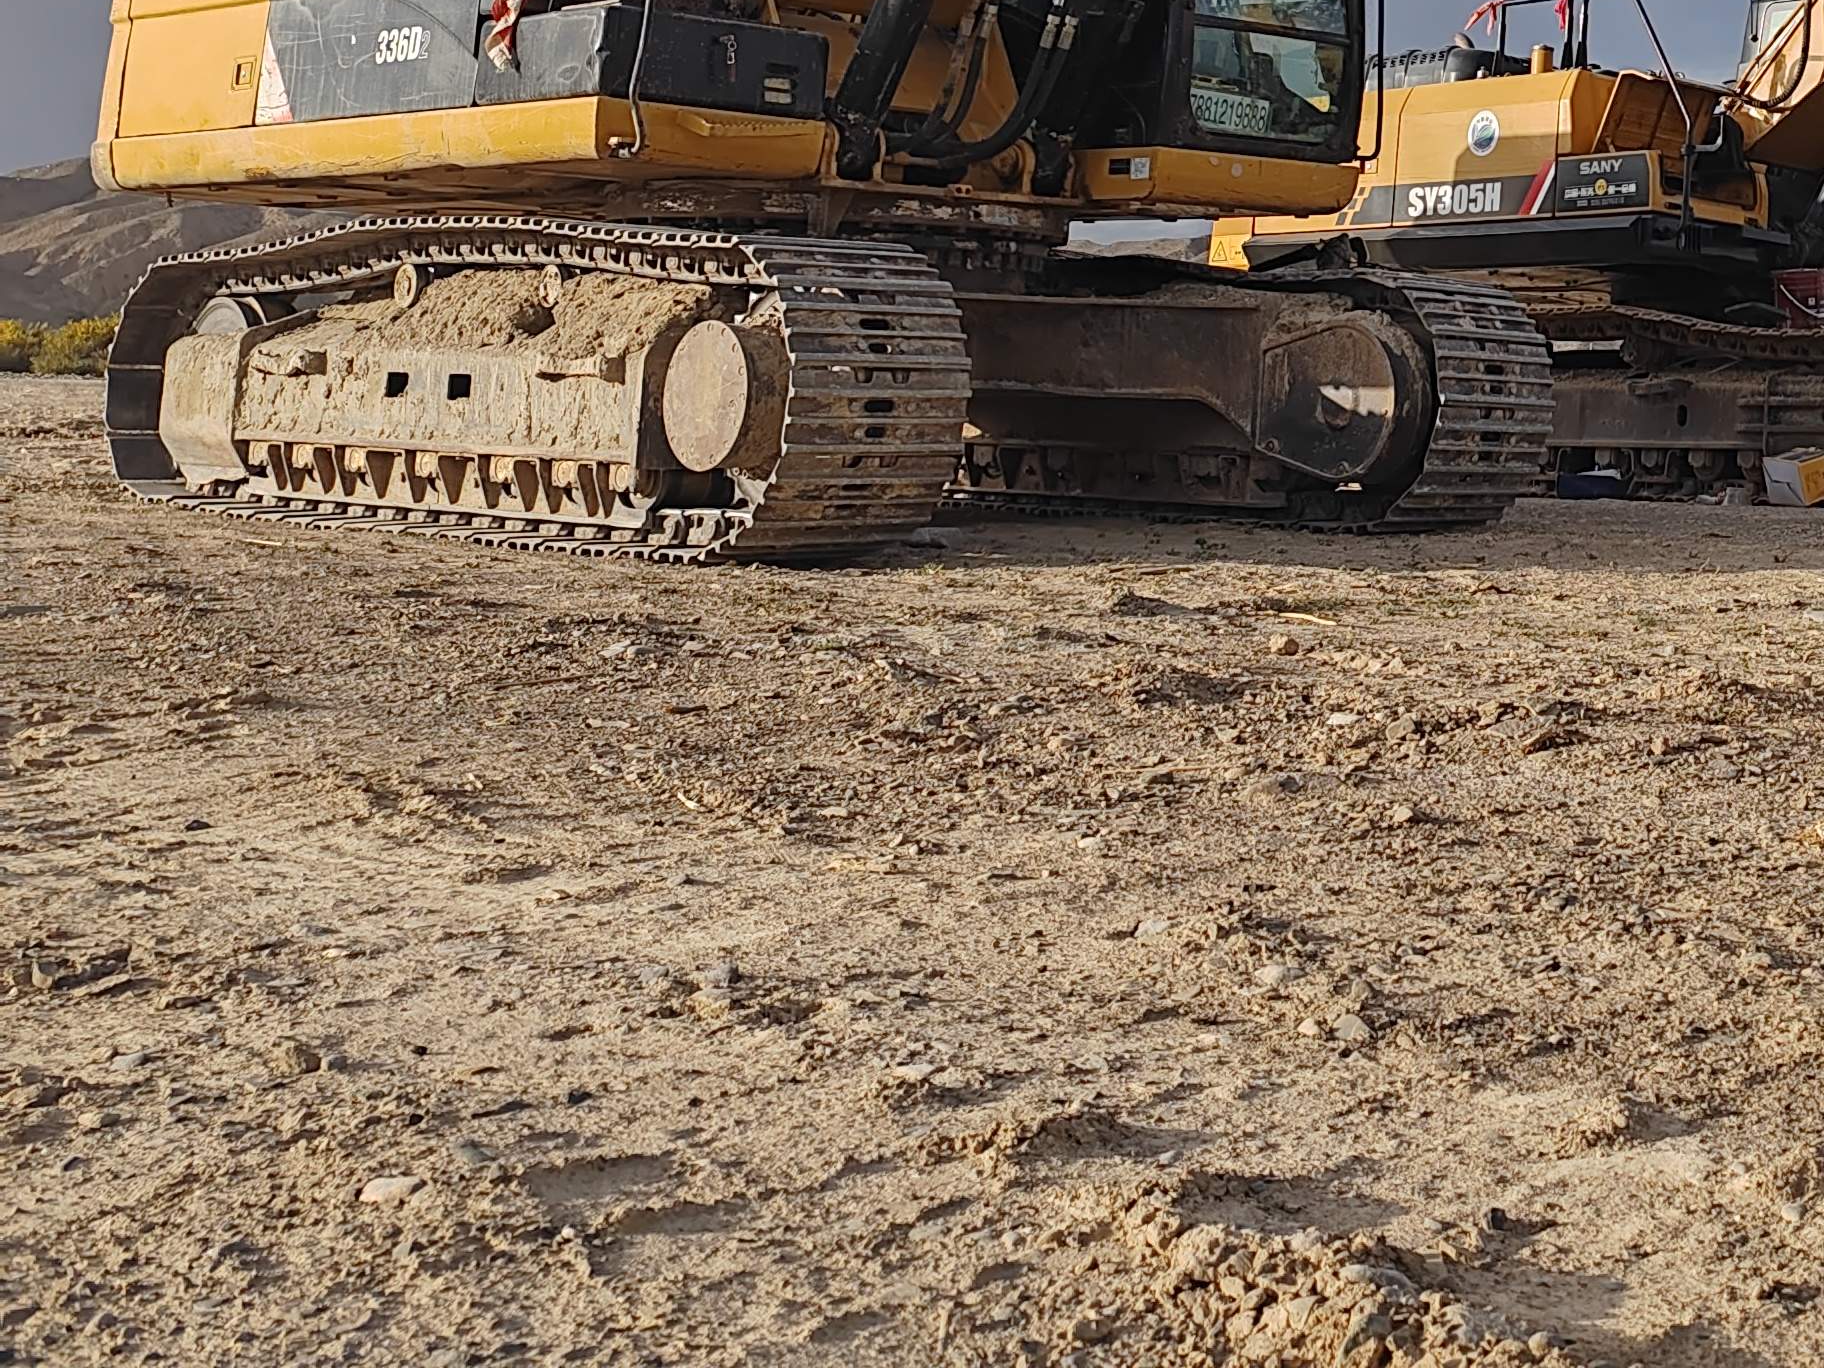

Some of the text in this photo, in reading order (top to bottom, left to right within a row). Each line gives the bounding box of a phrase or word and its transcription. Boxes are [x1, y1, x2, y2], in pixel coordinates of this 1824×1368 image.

[375, 25, 431, 65] 336D2
[1579, 158, 1623, 176] SANY
[1407, 181, 1502, 218] SY305H
